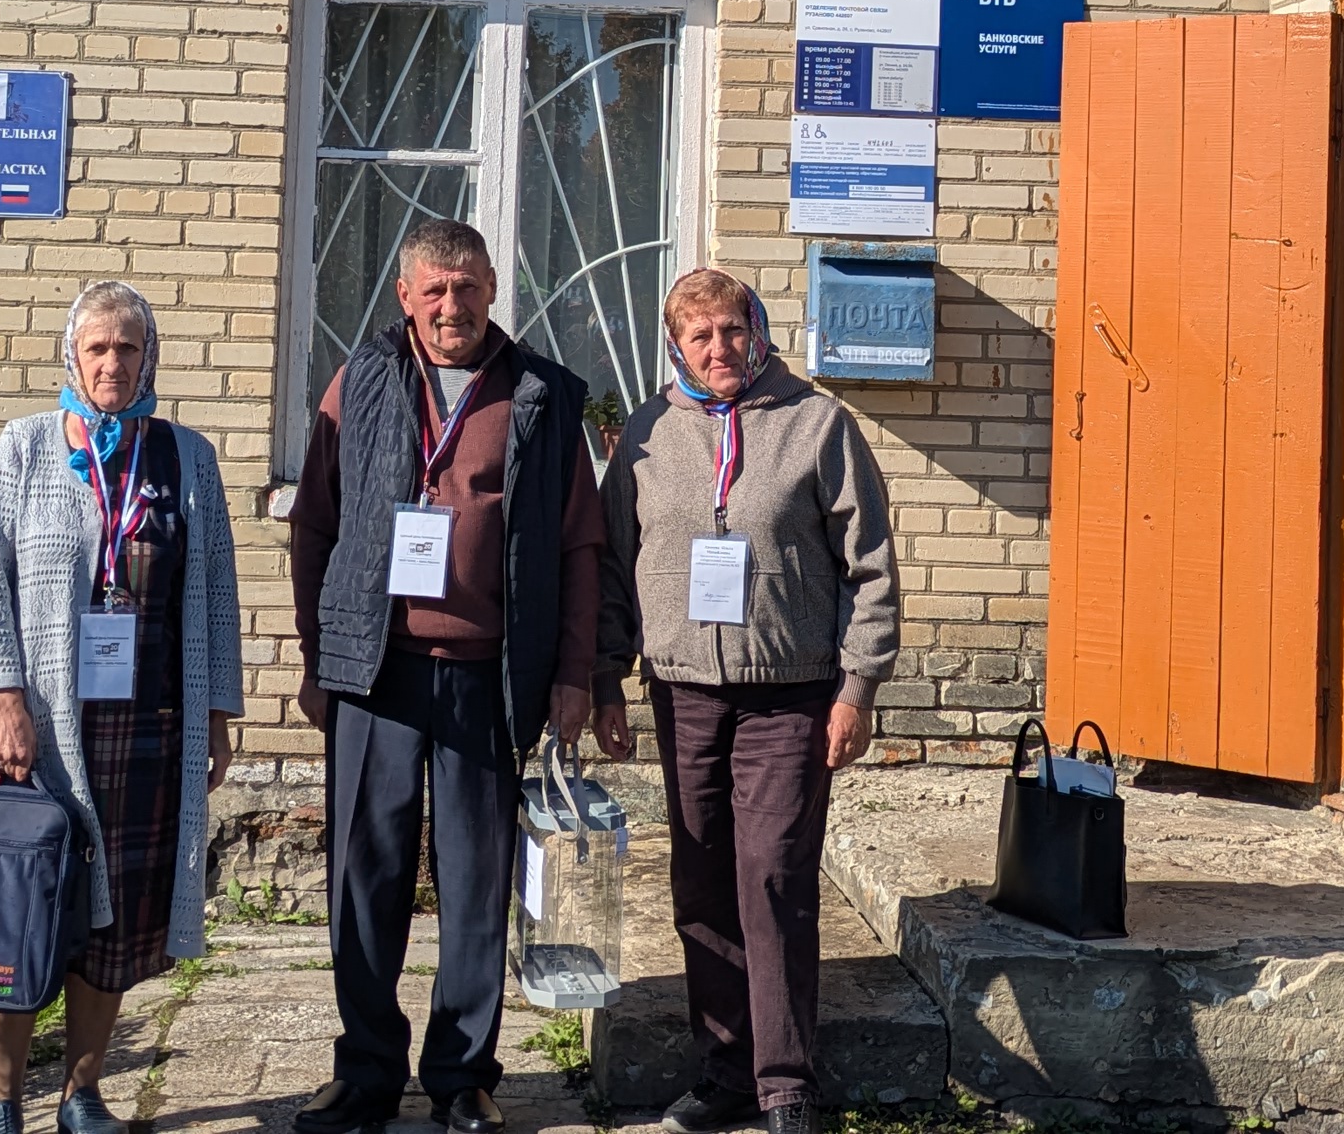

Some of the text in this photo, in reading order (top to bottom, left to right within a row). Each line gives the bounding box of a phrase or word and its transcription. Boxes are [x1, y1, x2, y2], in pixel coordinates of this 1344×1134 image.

[979, 33, 1044, 44] БАНКОВСКИЕ
[829, 46, 855, 54] работы
[979, 44, 1017, 55] УСЛУГИ
[828, 301, 927, 331] ПОЧТА
